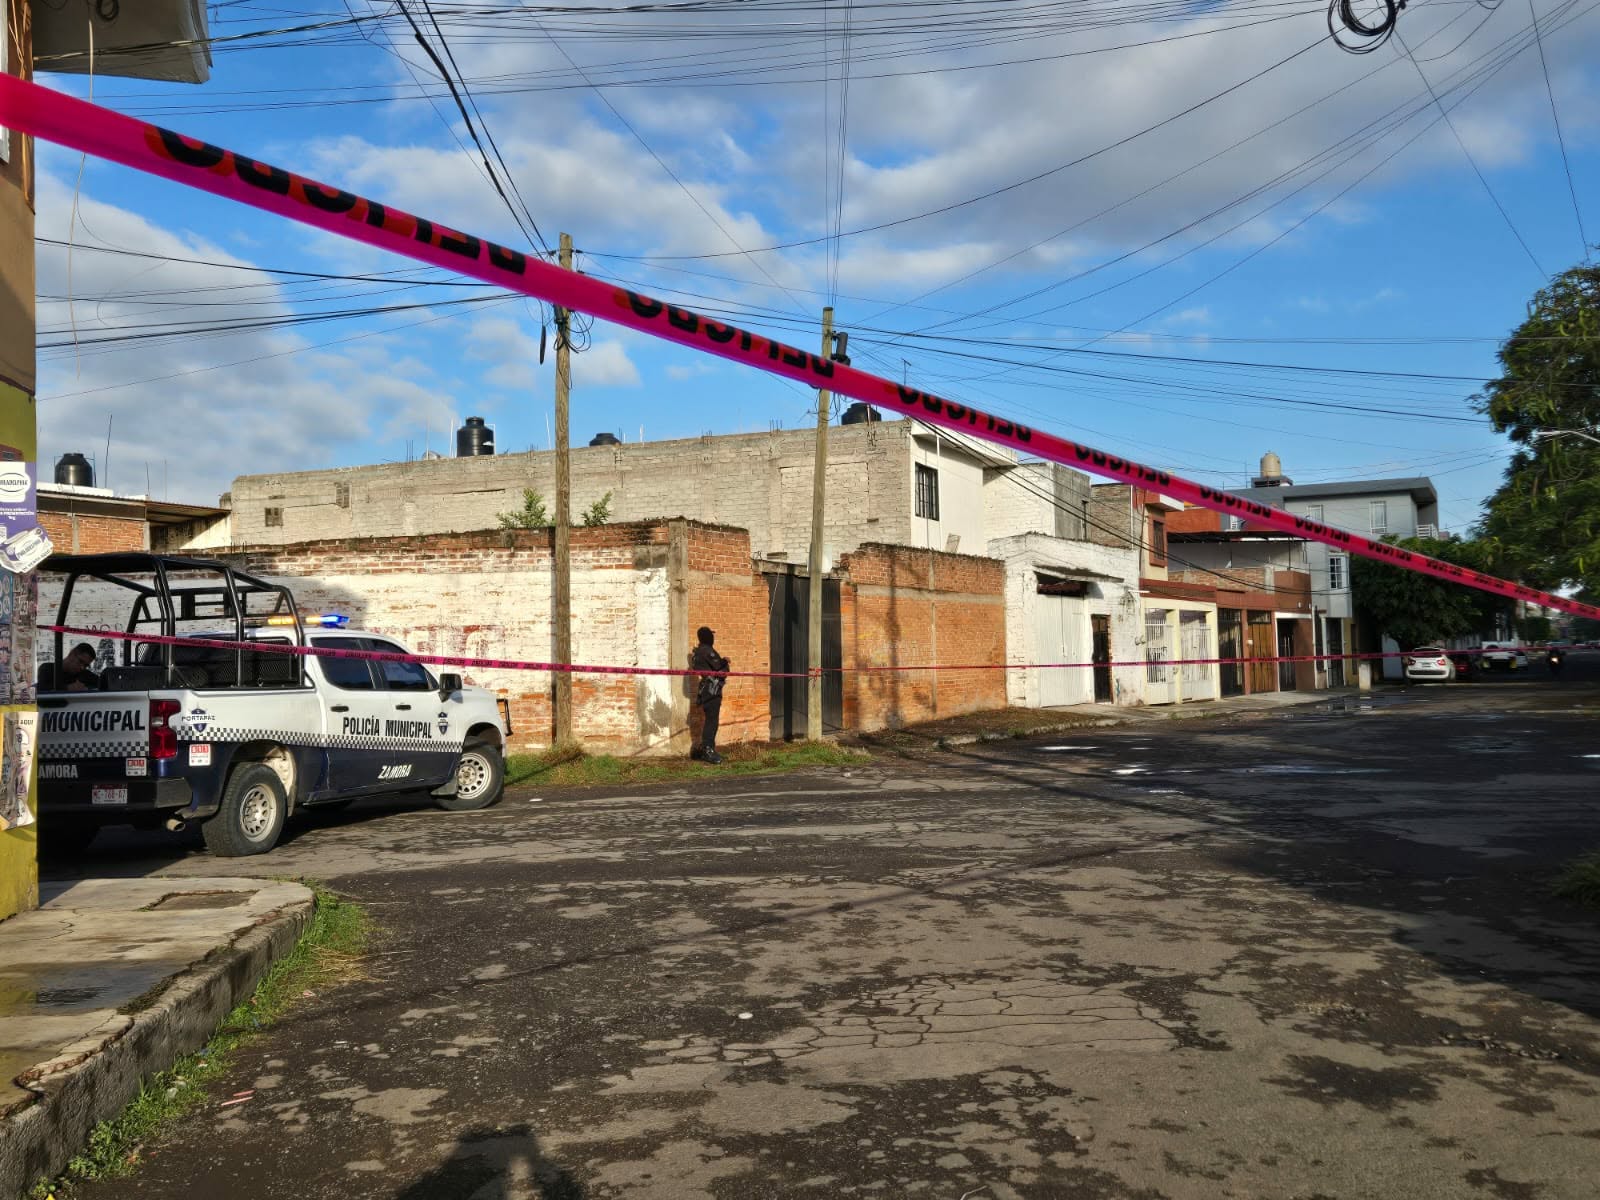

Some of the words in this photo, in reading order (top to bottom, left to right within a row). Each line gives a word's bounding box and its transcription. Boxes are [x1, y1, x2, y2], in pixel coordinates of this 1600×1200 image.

[41, 709, 146, 733] MUNICIPAL
[343, 714, 380, 736] POLICÍA
[385, 719, 432, 739] MUNICIPAL
[378, 764, 413, 779] ZAMORA
